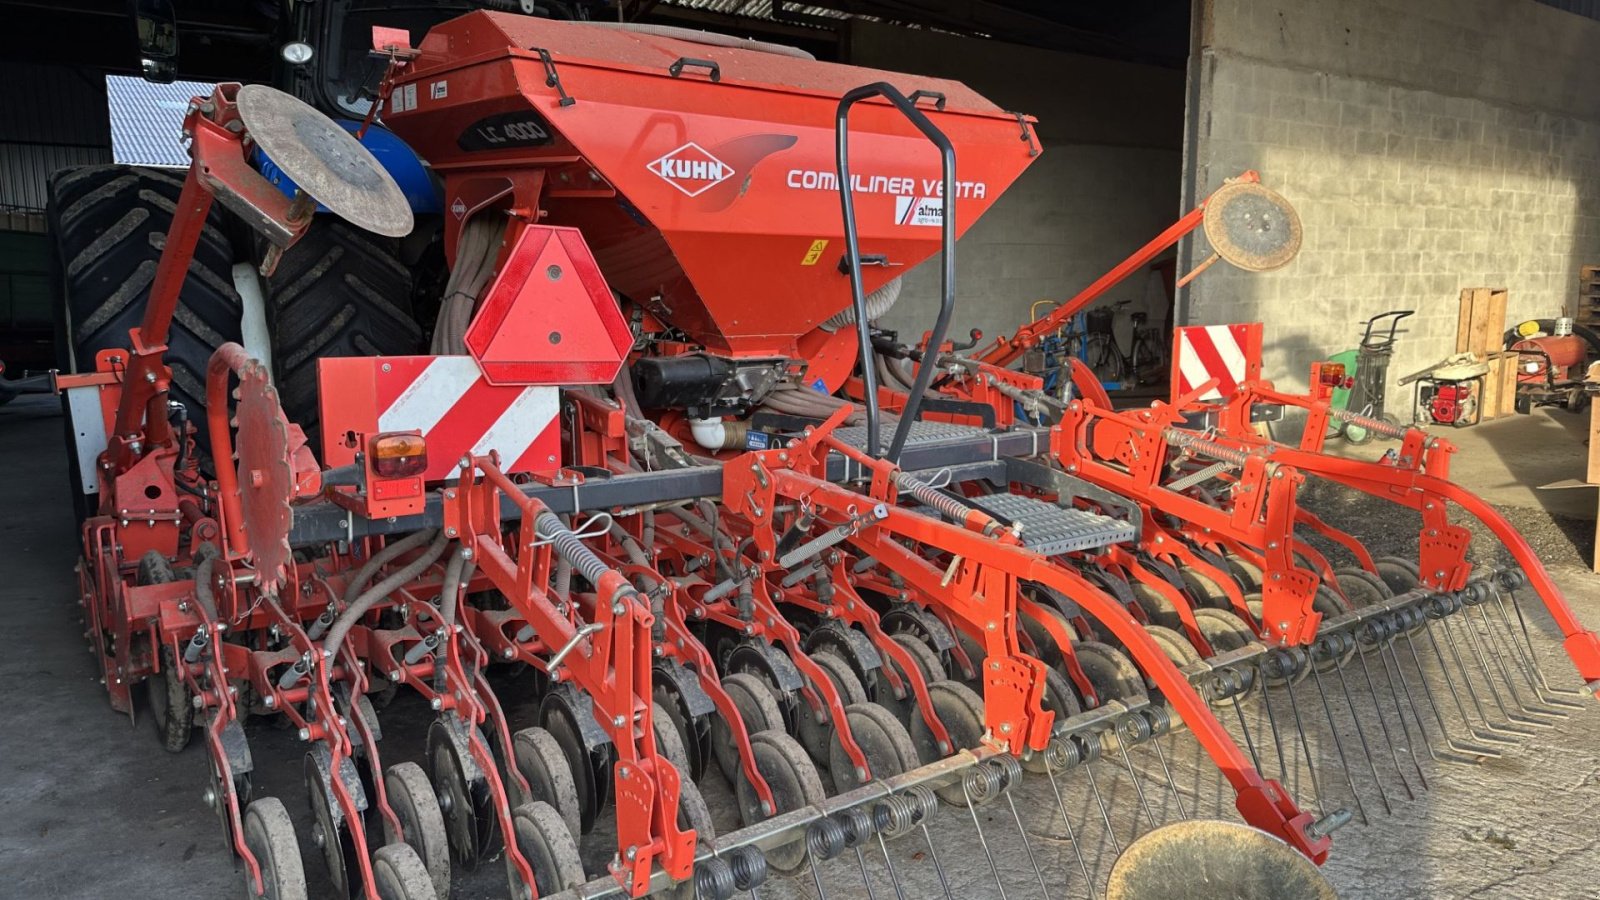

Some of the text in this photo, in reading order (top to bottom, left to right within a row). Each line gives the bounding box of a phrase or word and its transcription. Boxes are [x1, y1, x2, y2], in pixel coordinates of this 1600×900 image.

[477, 121, 548, 143] LC 4000
[660, 158, 723, 180] KUHN
[787, 169, 914, 195] COMILINER
